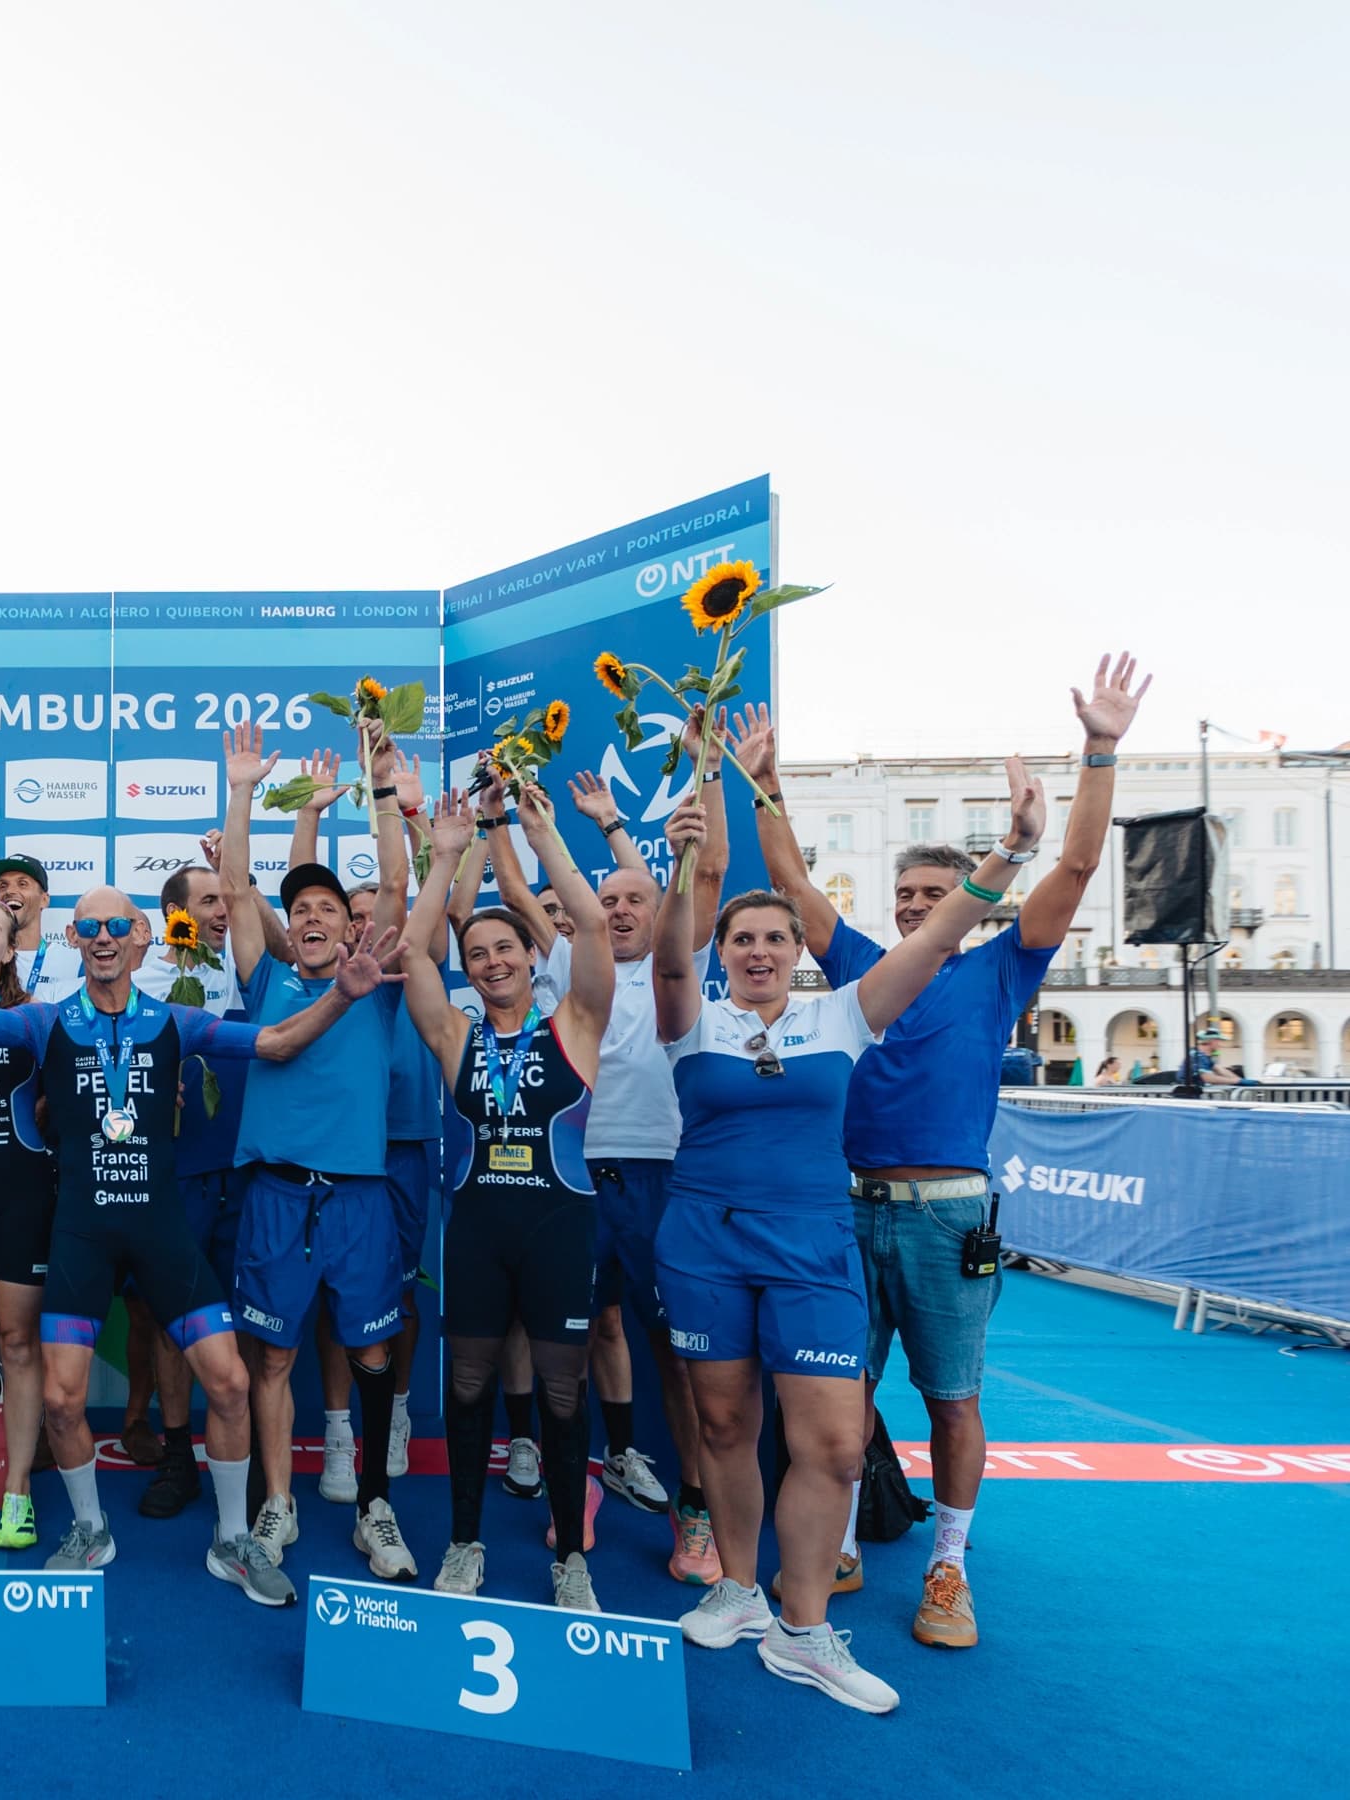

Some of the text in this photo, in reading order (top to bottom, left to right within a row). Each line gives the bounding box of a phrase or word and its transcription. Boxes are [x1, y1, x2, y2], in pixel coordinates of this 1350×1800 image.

[79, 605, 151, 619] ALGHERO
[166, 605, 244, 620] QUIBERON
[260, 605, 336, 618] HAMBURG
[353, 605, 418, 618] LONDON
[497, 565, 564, 597] KARLOVY
[566, 549, 607, 575] VARY
[626, 503, 740, 554] PONTEVEDRA
[194, 692, 312, 731] 2026
[46, 781, 98, 792] HAMBURG
[46, 790, 87, 800] WASSER
[144, 784, 207, 797] SUZUKI
[44, 860, 94, 872] UZUKI
[253, 860, 288, 871] SUZ
[76, 1070, 155, 1095] PEEL
[484, 1092, 527, 1117] FA
[92, 1150, 148, 1165] France
[92, 1166, 148, 1182] Travail
[477, 1173, 551, 1188] ottobock.
[1029, 1165, 1146, 1206] SUZUKI
[94, 1189, 150, 1206] GRAILUB
[363, 1306, 400, 1334] FRANCE
[794, 1349, 858, 1368] FRANCE
[37, 1585, 94, 1609] NTT
[353, 1594, 399, 1616] World
[353, 1609, 418, 1633] Triathlon
[604, 1629, 671, 1662] NTT
[458, 1620, 519, 1715] 3
